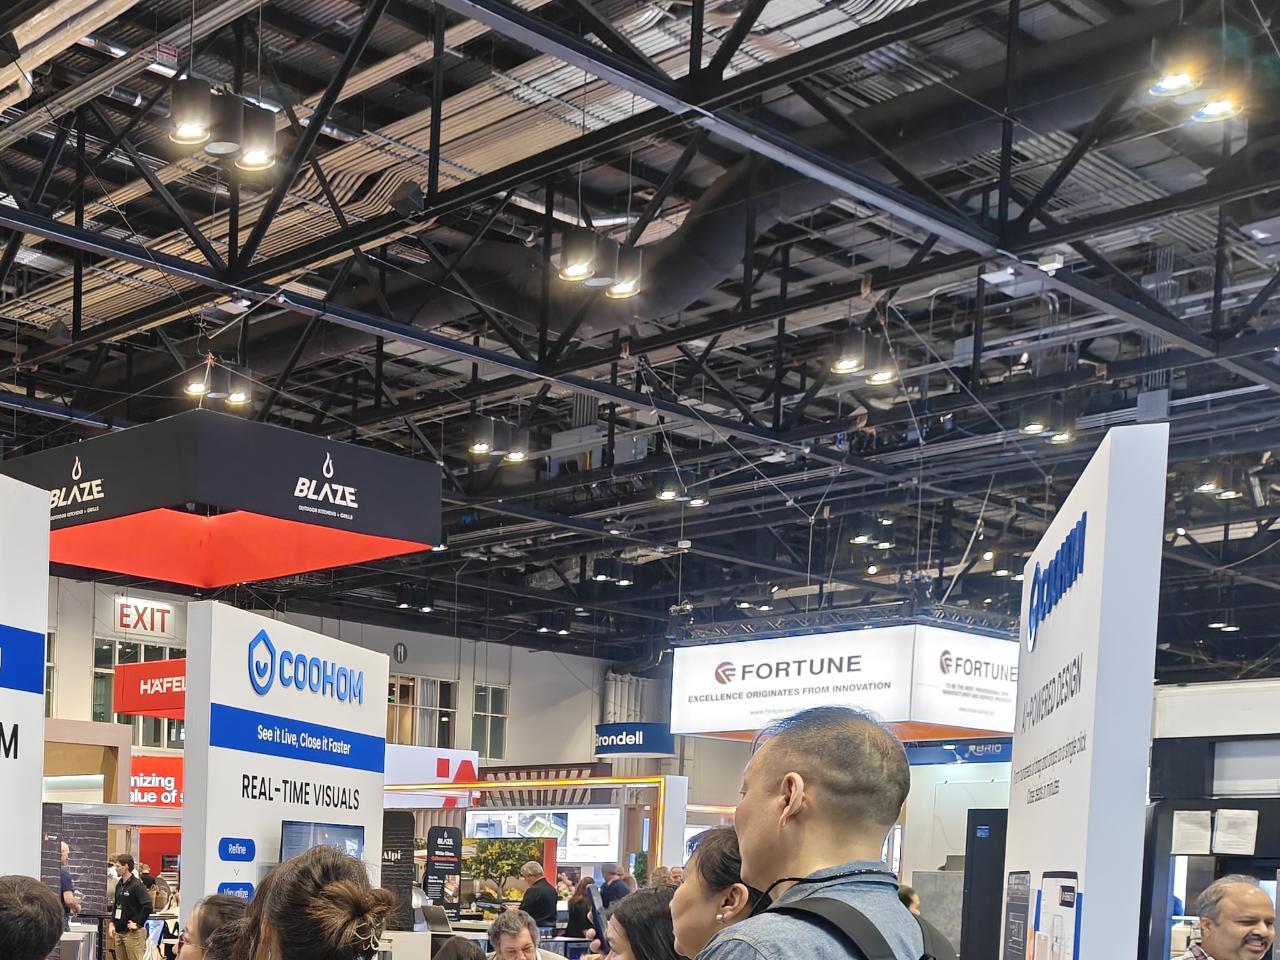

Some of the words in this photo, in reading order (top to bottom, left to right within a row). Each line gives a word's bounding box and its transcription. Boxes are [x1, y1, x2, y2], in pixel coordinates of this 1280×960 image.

[50, 479, 104, 508] BLAZE
[294, 477, 358, 508] BLAZE
[119, 603, 171, 633] EXIT
[279, 650, 365, 706] COOHOM
[741, 655, 862, 680] FORTUNE
[955, 657, 1019, 682] FORTUNE
[688, 692, 743, 703] EXCELLENCE
[746, 688, 800, 700] ORIGINATES
[802, 685, 830, 695] FROM
[832, 681, 892, 694] INNOVATION
[257, 724, 273, 741] See
[274, 728, 280, 743] it
[281, 729, 298, 748] Live,
[300, 731, 321, 750] Close
[322, 736, 328, 751] it
[329, 737, 351, 755] Faster
[161, 790, 177, 804] of
[242, 773, 311, 806] REAL-TIME
[313, 784, 360, 811] VISUALS
[228, 843, 247, 855] Refine
